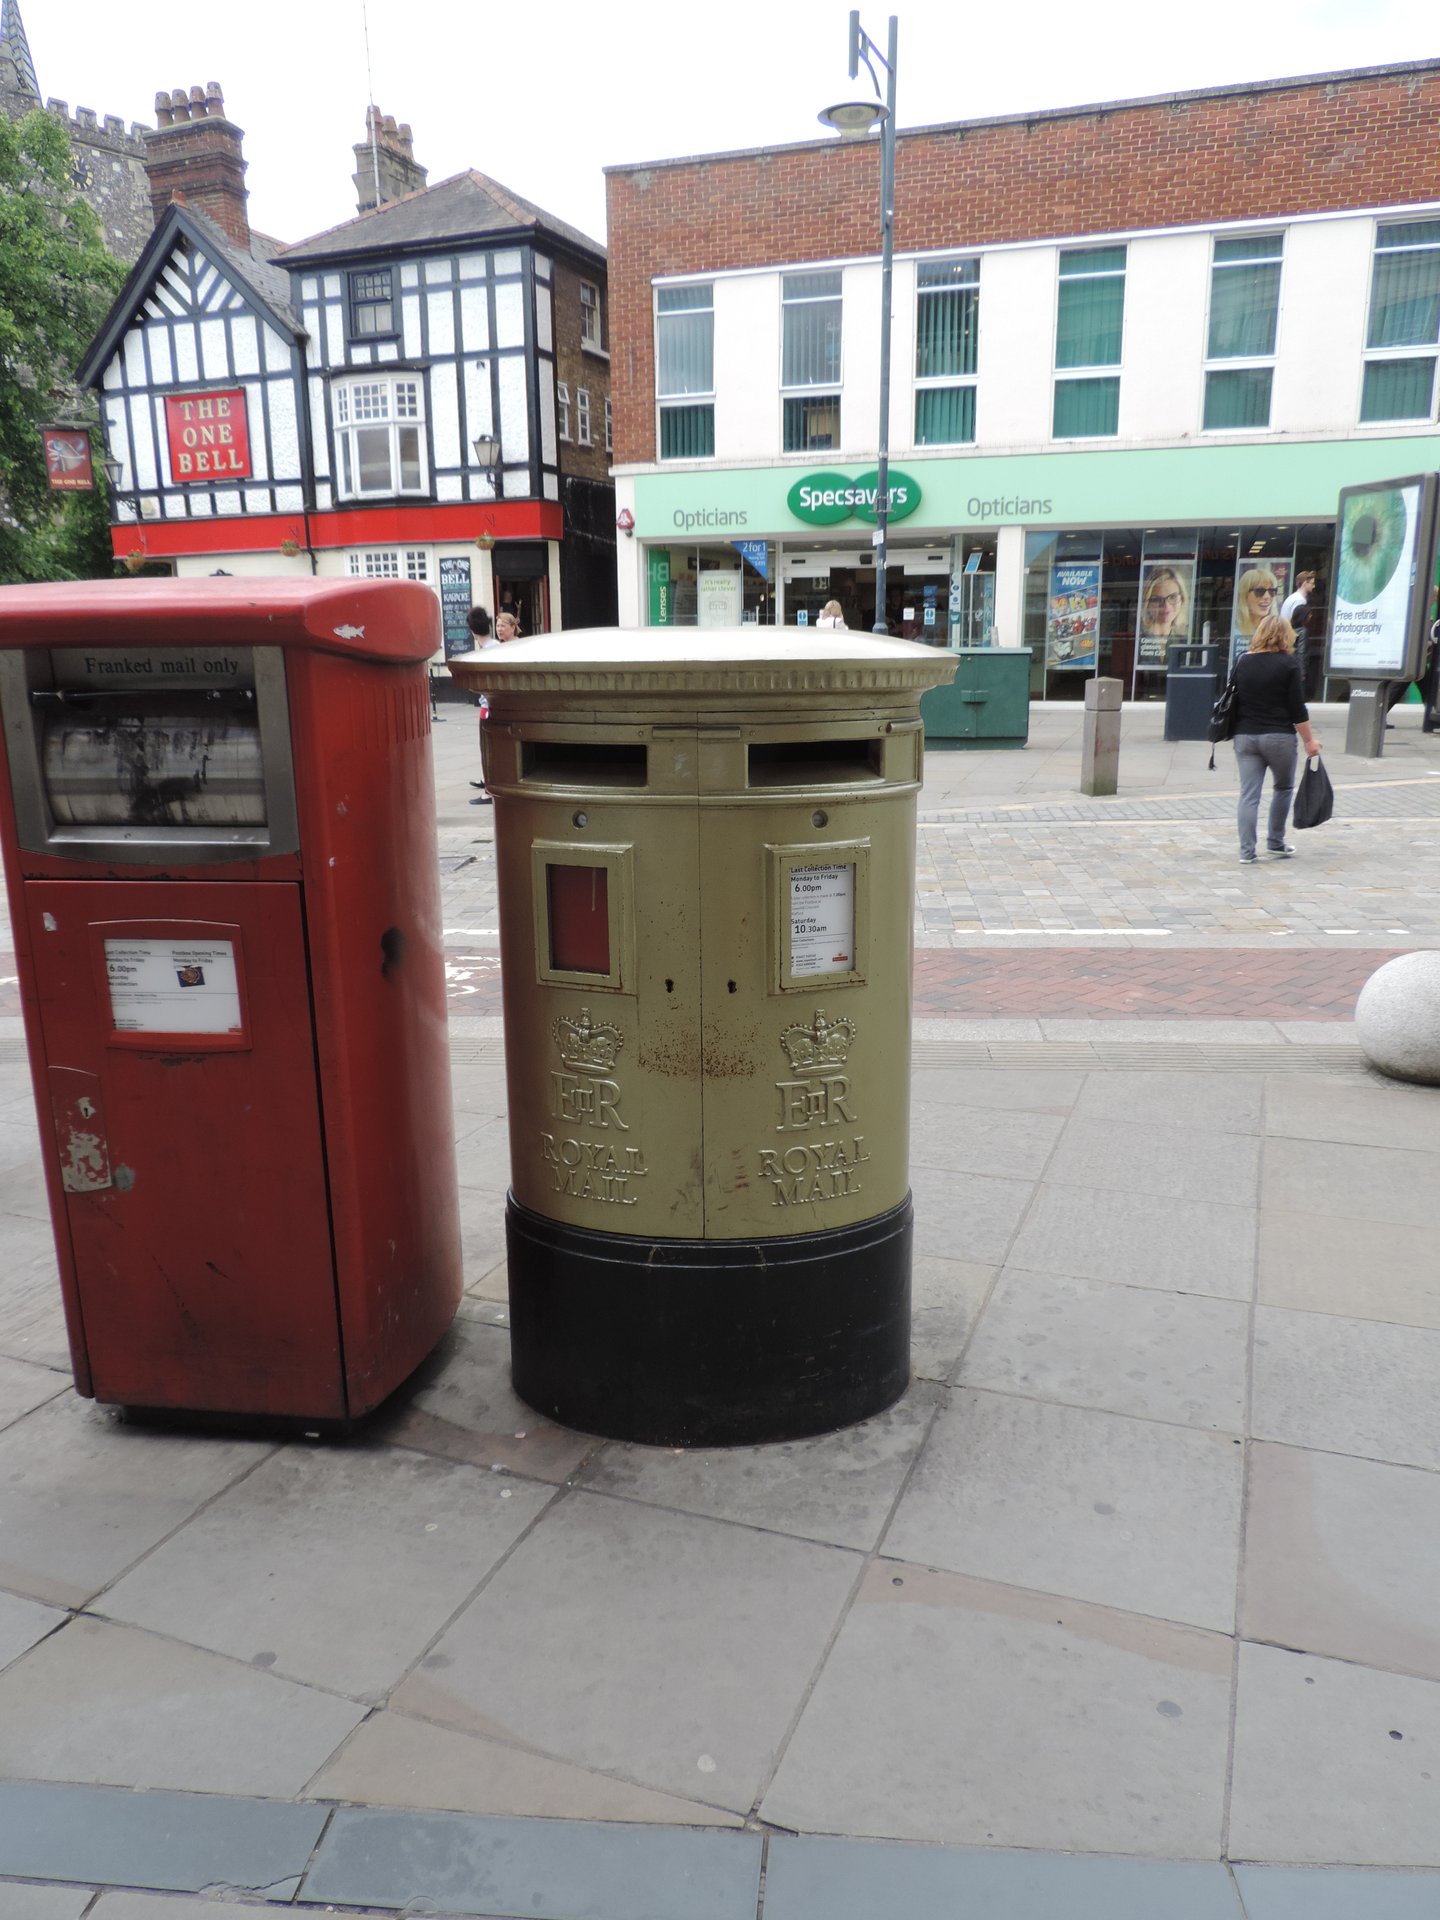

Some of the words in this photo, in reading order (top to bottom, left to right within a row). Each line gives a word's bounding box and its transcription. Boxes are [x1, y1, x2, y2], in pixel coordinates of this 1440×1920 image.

[179, 397, 232, 421] THE
[183, 424, 233, 448] ONE
[178, 449, 244, 474] BELL
[799, 486, 908, 511] Specsavrs
[967, 496, 1053, 520] Opticians
[673, 508, 748, 531] Opticians
[743, 543, 749, 552] 2
[749, 542, 761, 552] for
[441, 560, 453, 570] THE
[457, 560, 470, 571] ONE
[441, 574, 470, 584] BELL
[1062, 577, 1088, 586] NOW
[443, 592, 470, 602] KARAOKE
[659, 586, 667, 622] Lenses
[1336, 610, 1353, 620] Free
[1354, 609, 1378, 620] retinal
[1335, 623, 1382, 634] photography
[85, 657, 153, 674] Franked
[160, 657, 196, 673] mail
[203, 657, 239, 676] only
[804, 865, 831, 873] Collection
[795, 884, 822, 892] 6.00pm
[795, 925, 827, 934] 10.30am
[109, 964, 137, 972] 6.00pm
[540, 1132, 648, 1175] ROYAL
[758, 1136, 871, 1176] ROYAL
[552, 1165, 637, 1205] MAIL
[772, 1169, 861, 1206] MAIL
